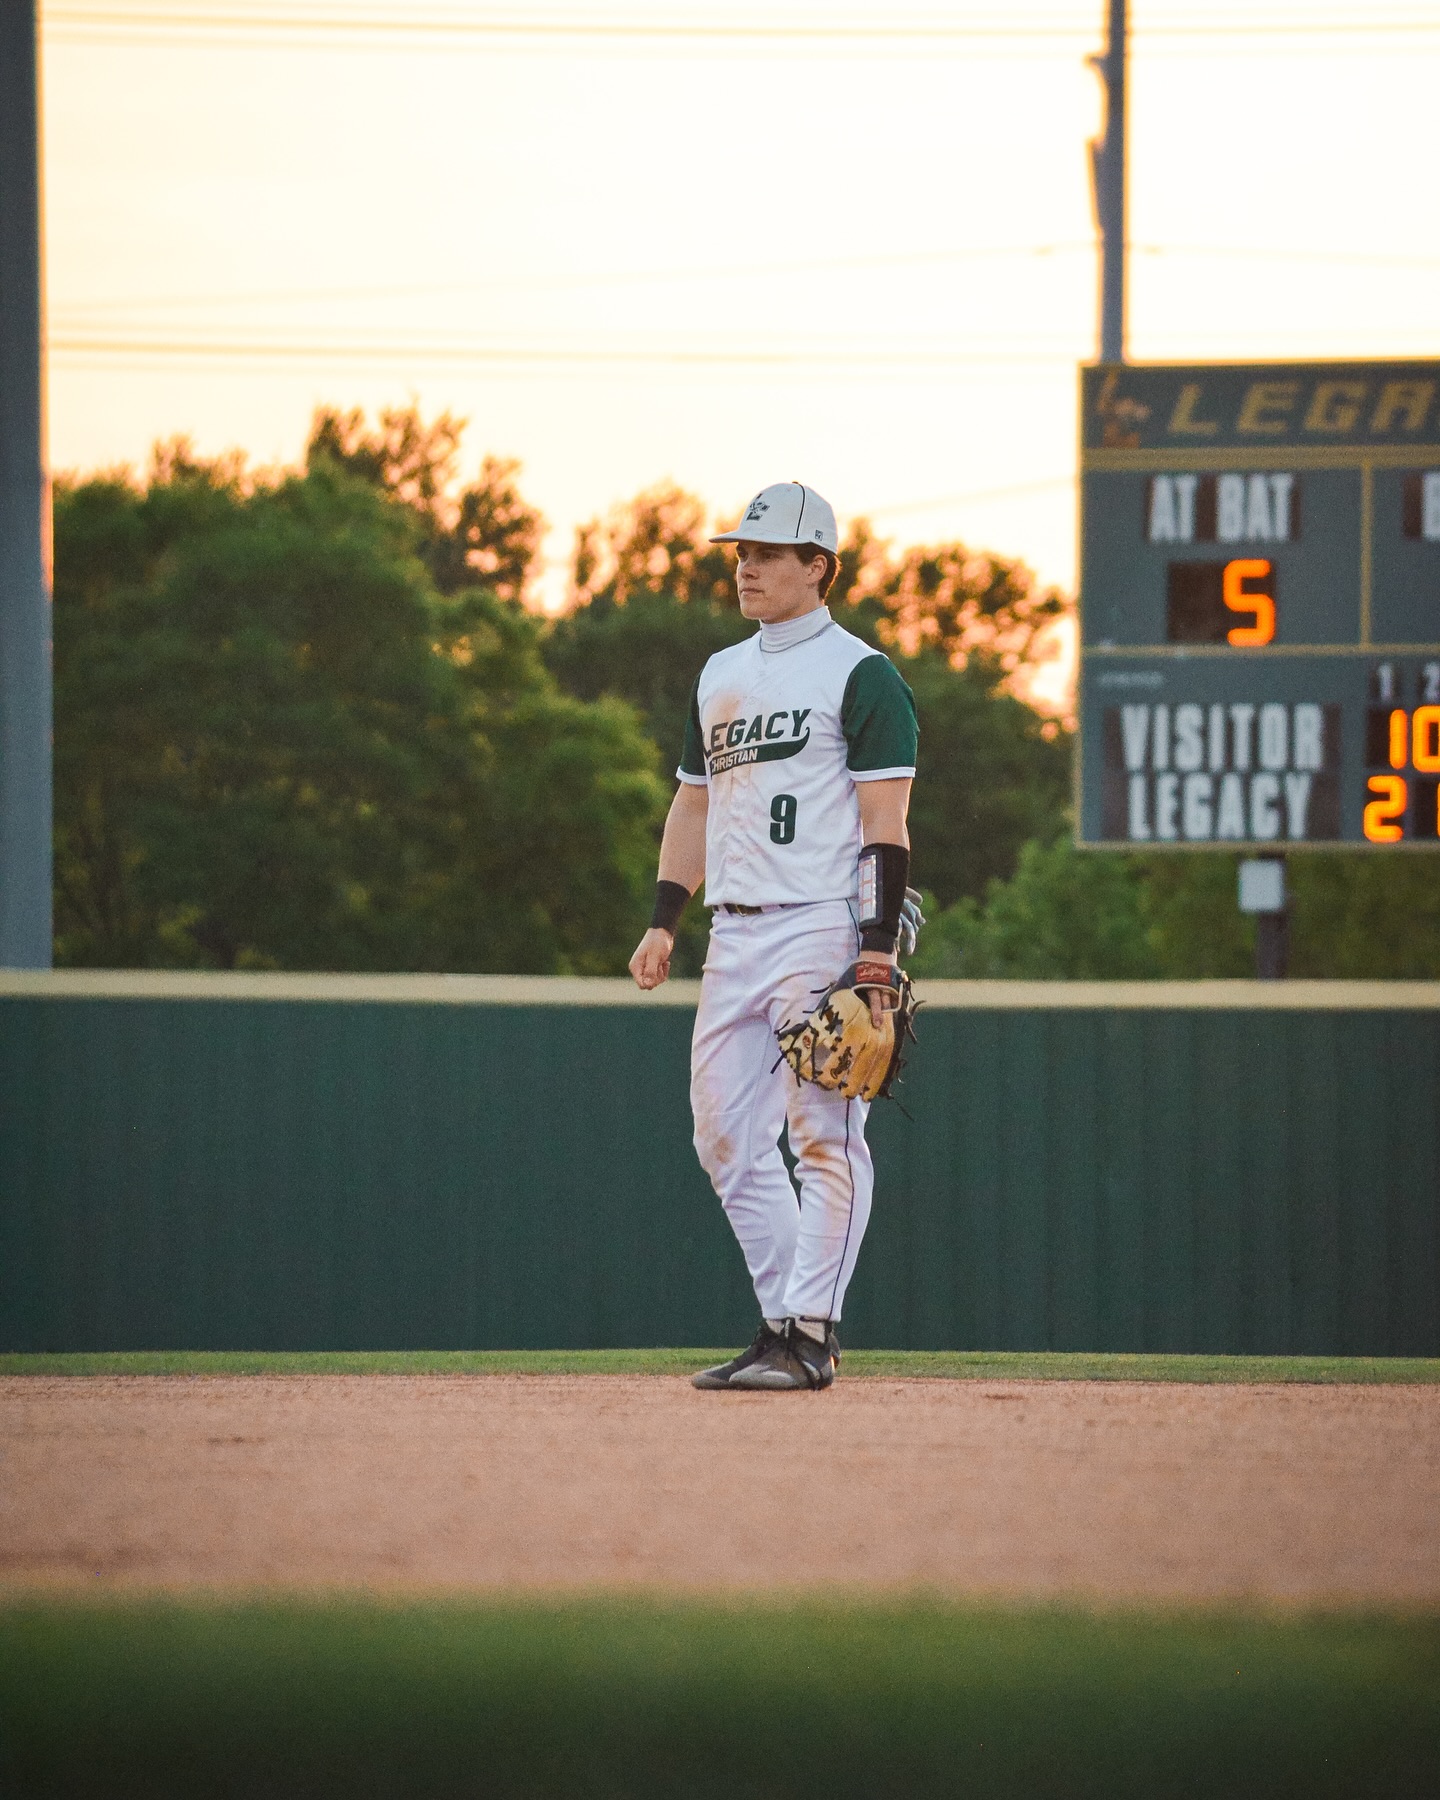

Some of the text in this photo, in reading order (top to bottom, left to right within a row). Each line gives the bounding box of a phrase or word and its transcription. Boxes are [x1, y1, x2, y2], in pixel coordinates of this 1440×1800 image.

[1150, 473, 1293, 542] AT BAT
[1121, 702, 1323, 771] VISITOR
[769, 794, 798, 845] 9
[1129, 772, 1312, 840] LEGACY
[1363, 775, 1408, 843] 2
